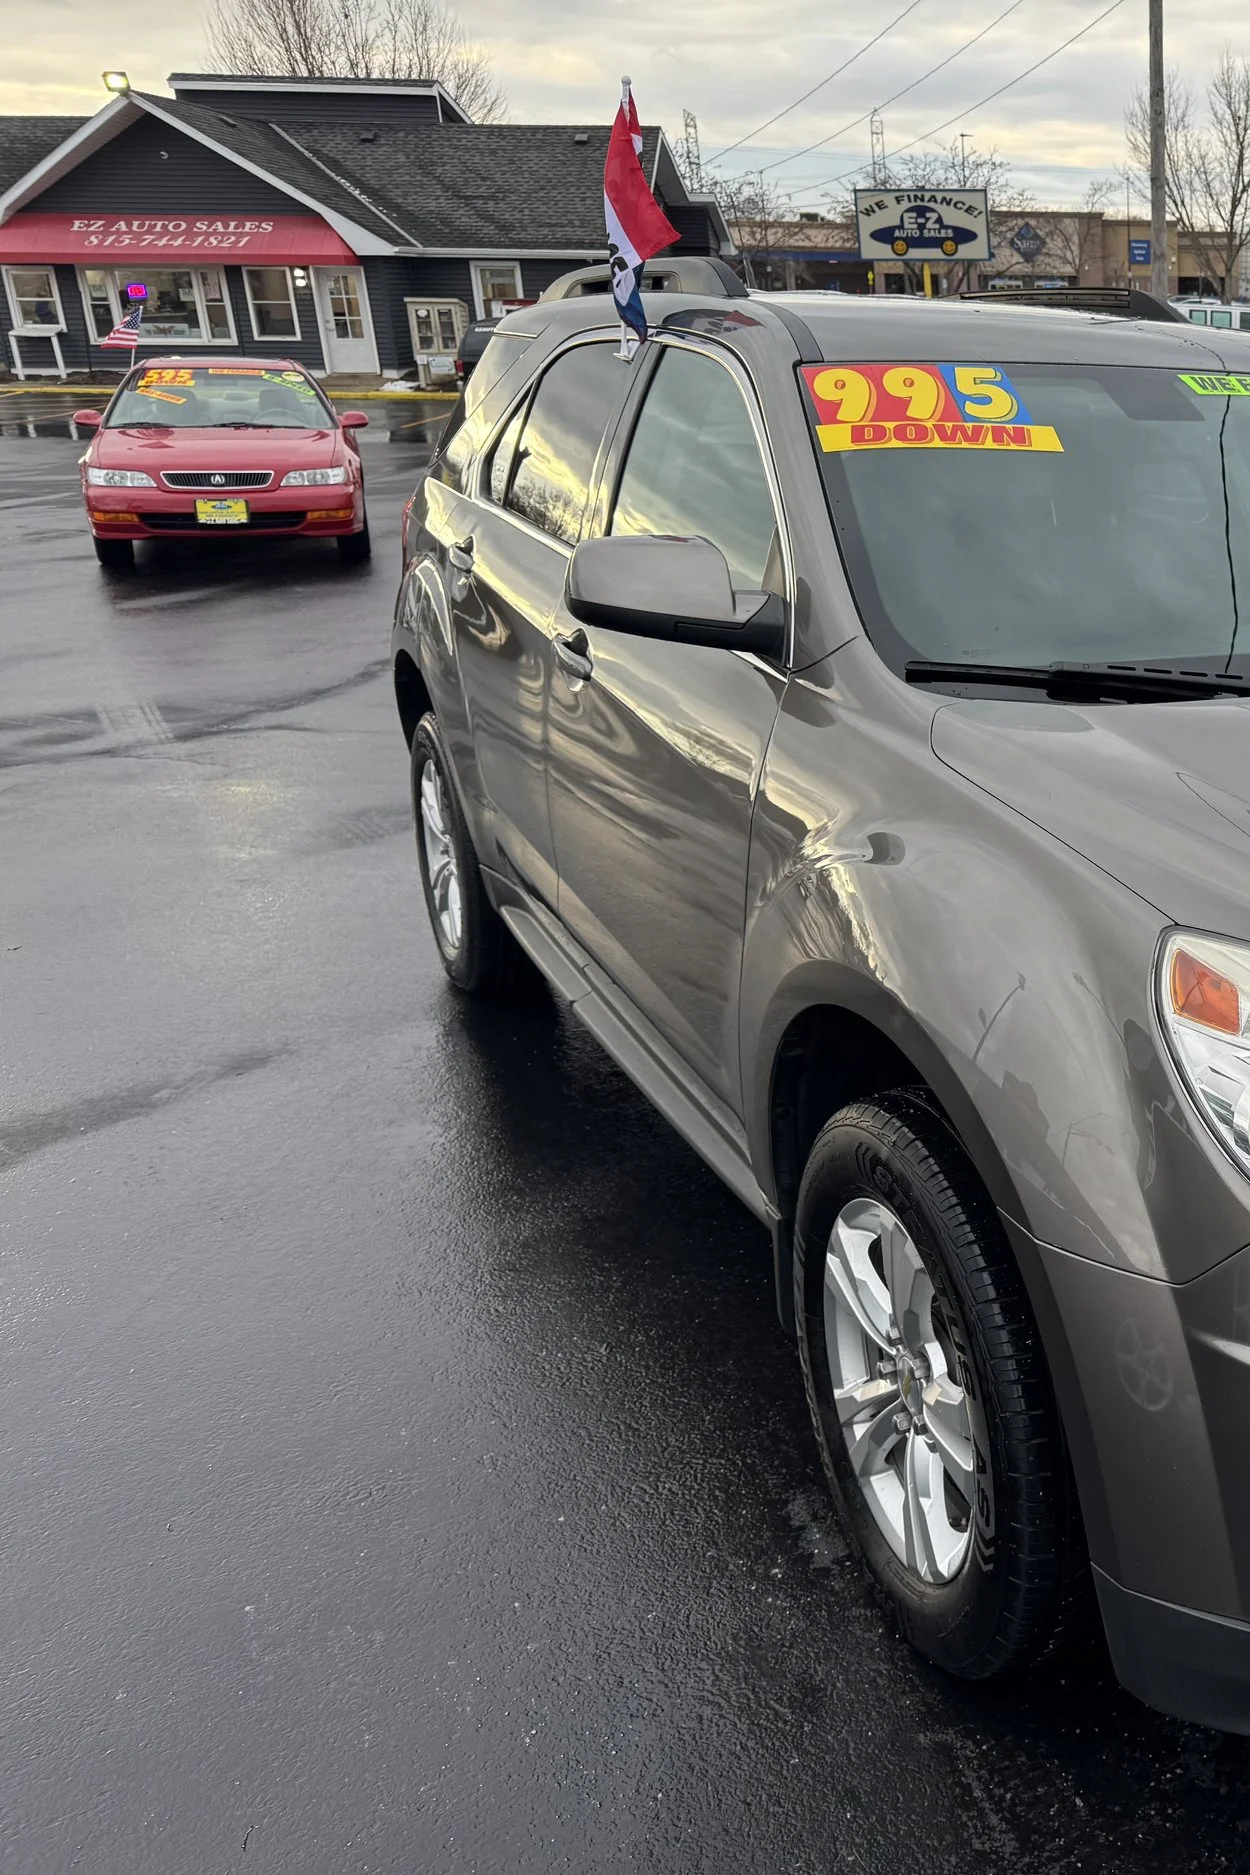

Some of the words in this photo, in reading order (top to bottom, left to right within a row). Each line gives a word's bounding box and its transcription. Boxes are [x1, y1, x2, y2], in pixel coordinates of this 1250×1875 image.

[860, 200, 888, 217] WE
[894, 194, 983, 219] FINANCE!
[70, 220, 105, 231] EZ
[110, 220, 187, 232] AUTO
[193, 221, 274, 233] SALES
[902, 212, 940, 229] E-Z
[84, 234, 251, 247] 815-744-1821
[894, 229, 919, 238] AUTO
[923, 229, 954, 238] SALES
[144, 368, 193, 381] 595
[1191, 376, 1237, 393] WE
[813, 367, 1019, 422] 995
[851, 423, 1033, 447] DOWN
